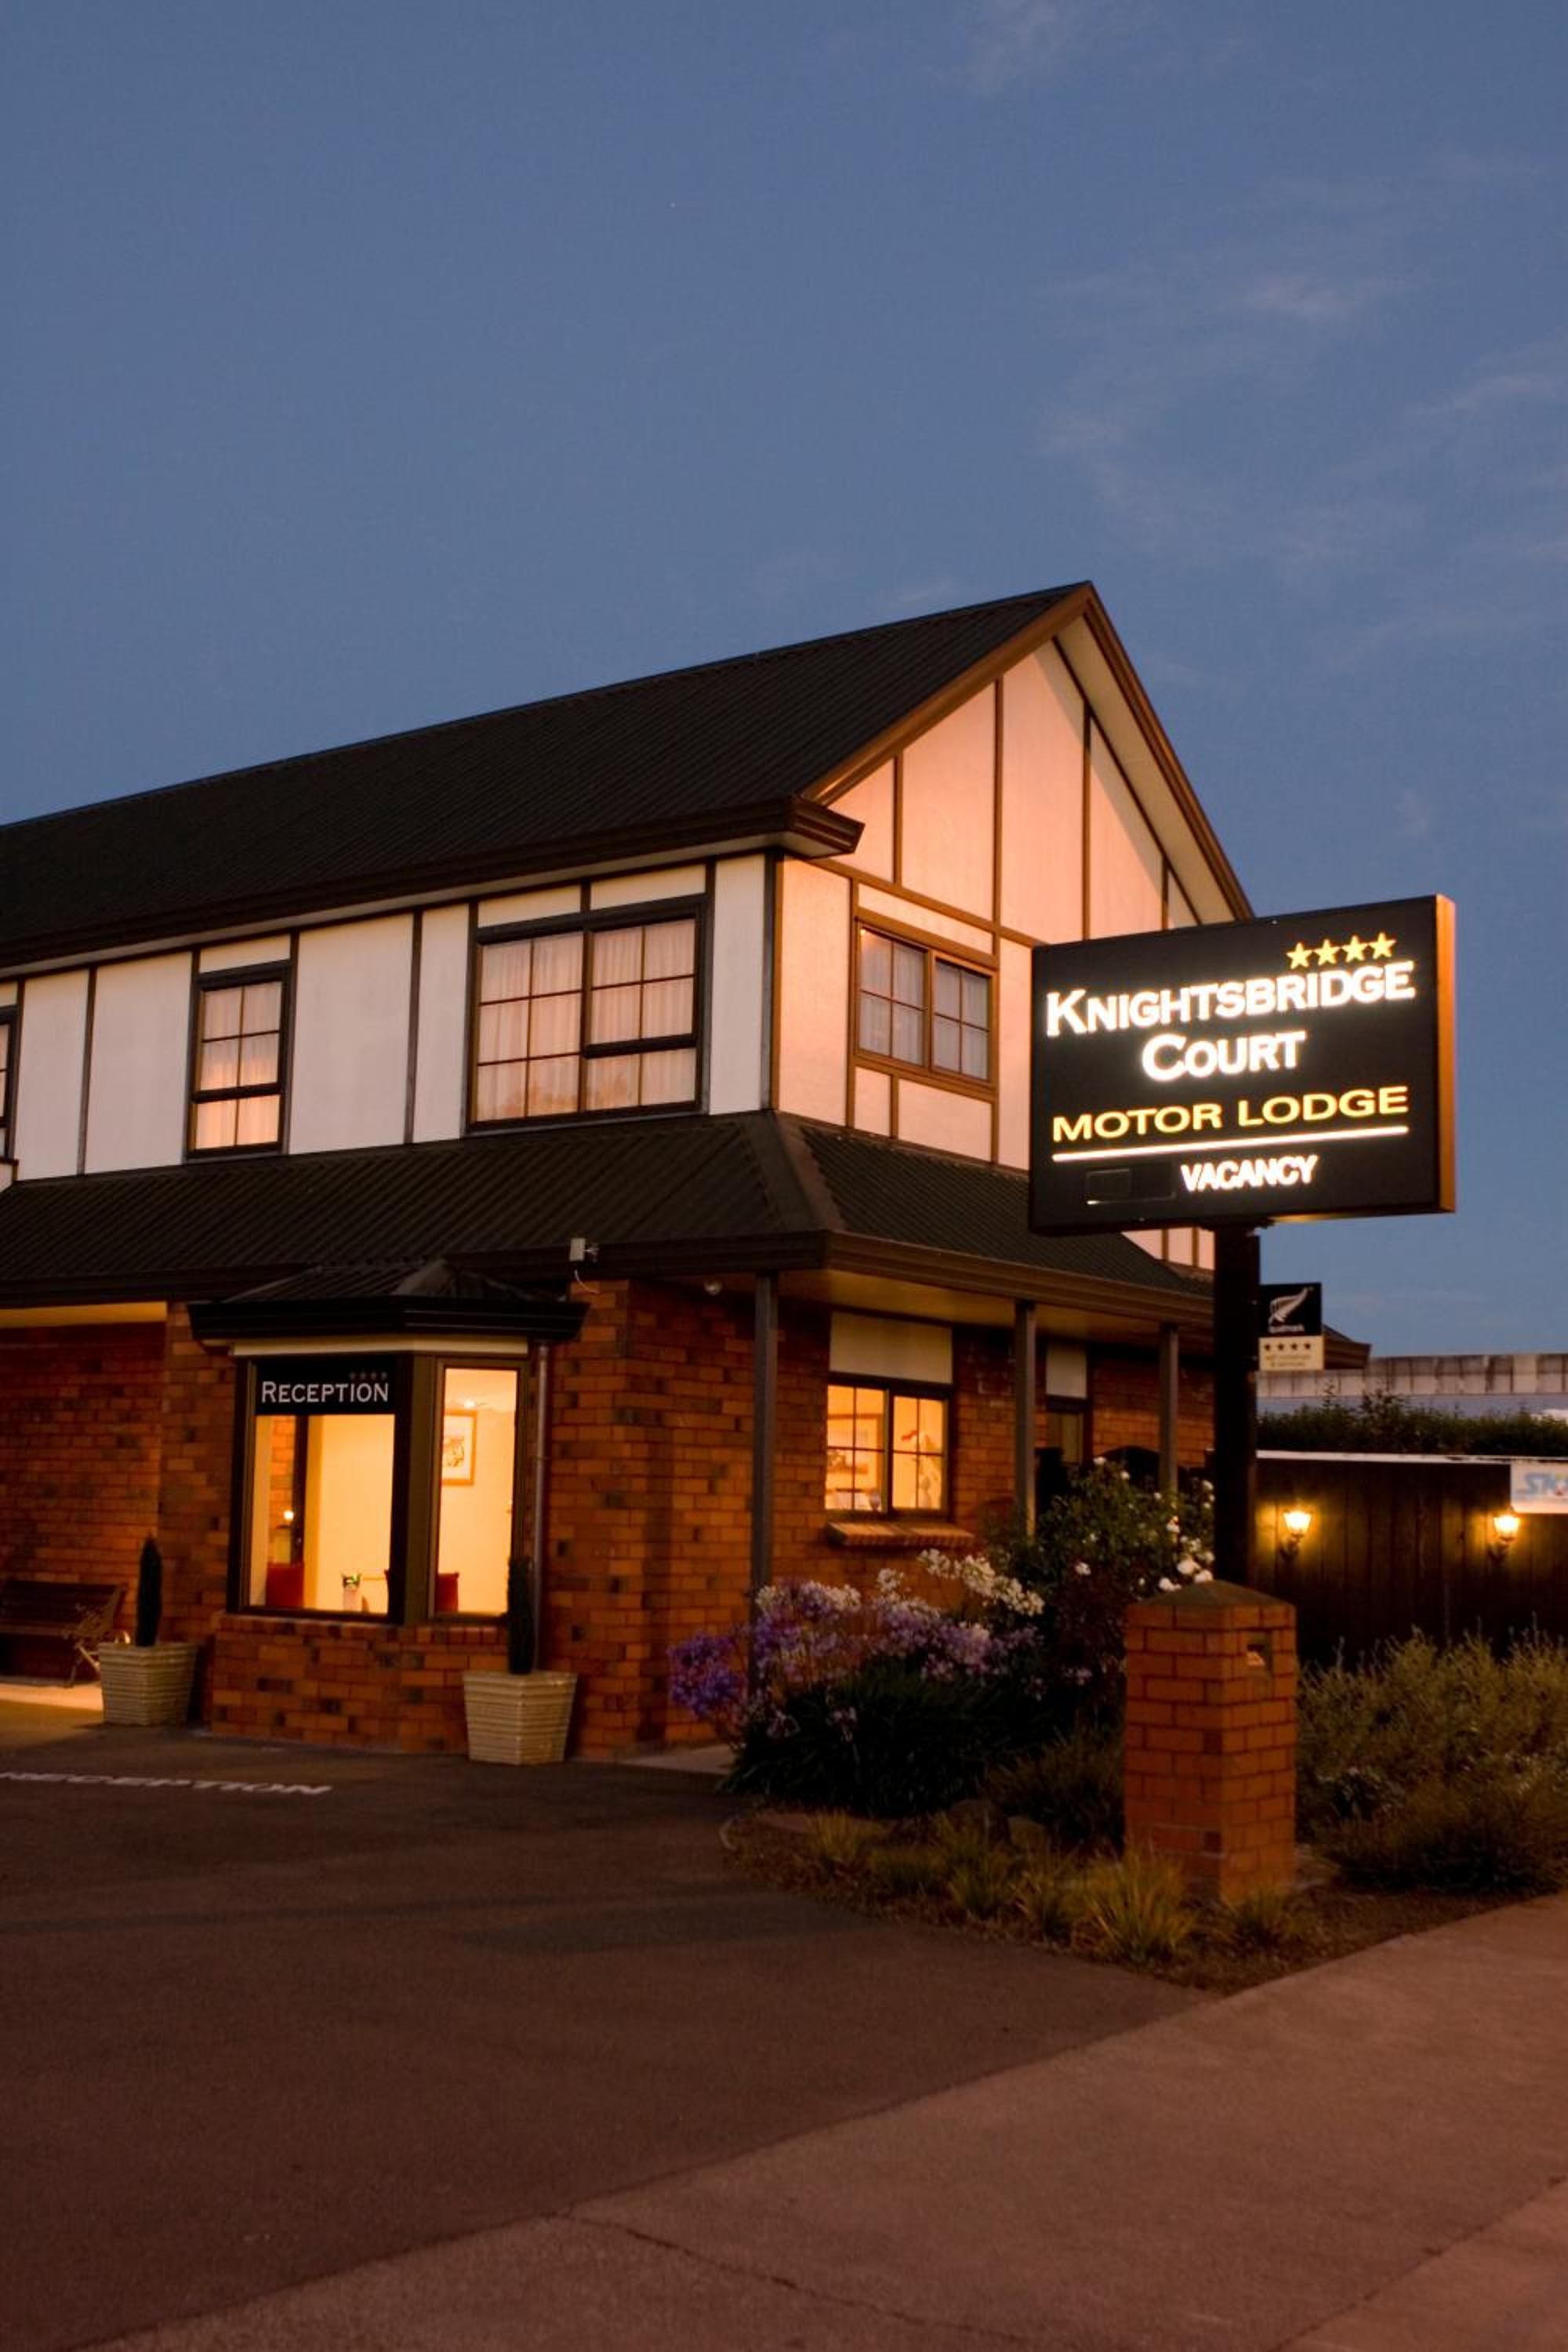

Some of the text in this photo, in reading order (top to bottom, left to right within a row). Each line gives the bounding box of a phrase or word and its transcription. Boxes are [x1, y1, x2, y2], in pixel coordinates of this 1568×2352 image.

[1047, 961, 1416, 1036] KNIGHTSBRIDGE
[1142, 1030, 1307, 1082] COURT
[1052, 1085, 1409, 1142] MOTOR LODGE
[1180, 1154, 1319, 1192] VACANCY
[262, 1381, 389, 1403] RECEPTION
